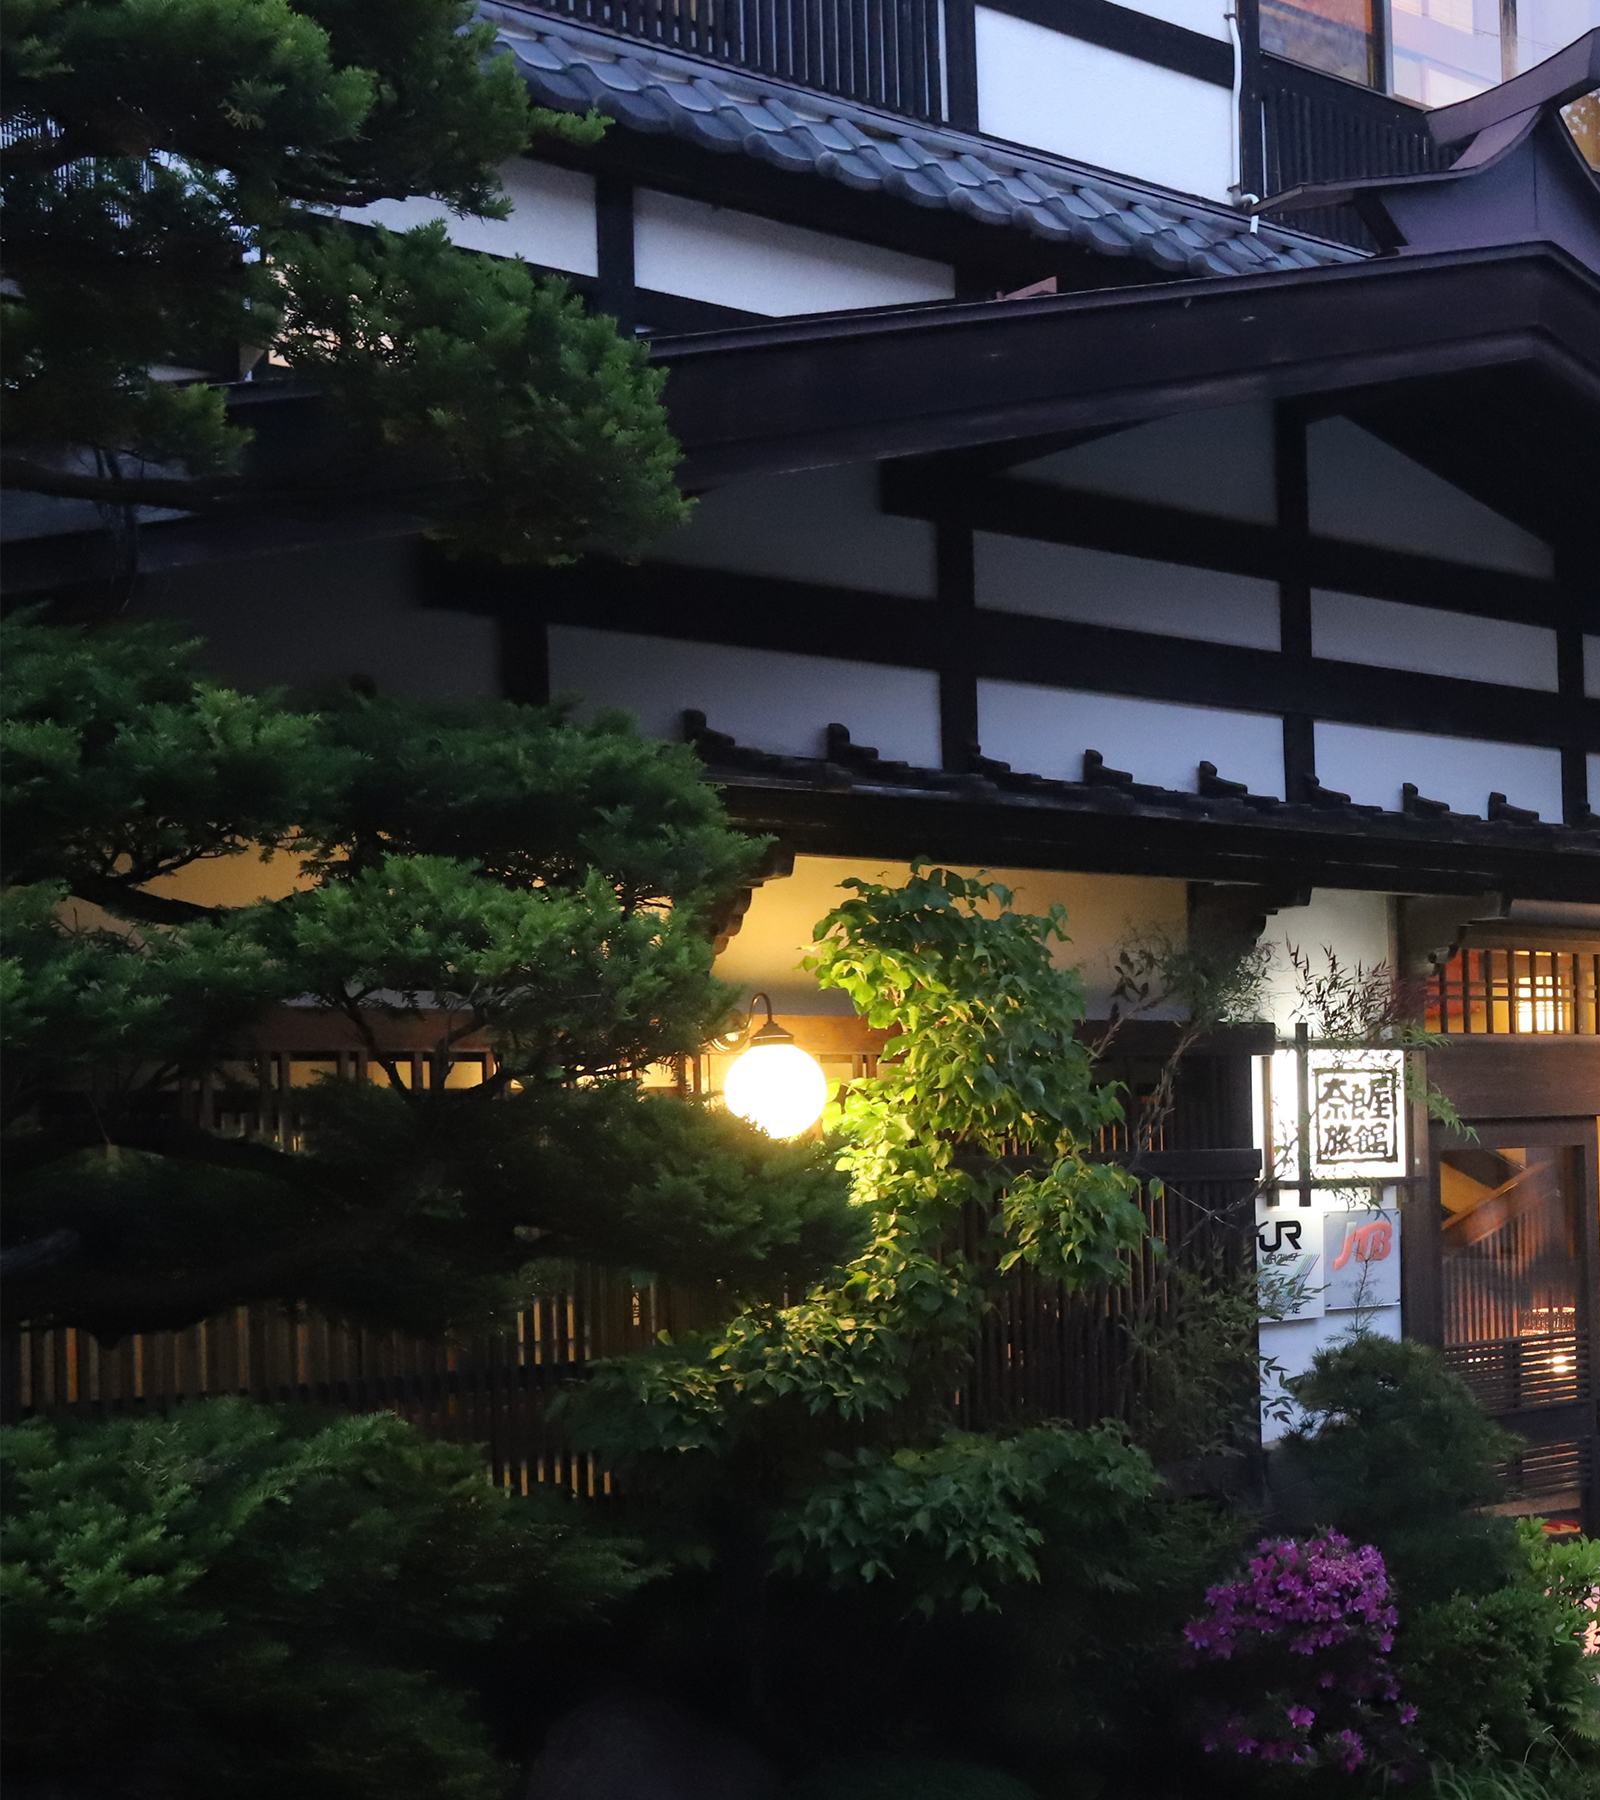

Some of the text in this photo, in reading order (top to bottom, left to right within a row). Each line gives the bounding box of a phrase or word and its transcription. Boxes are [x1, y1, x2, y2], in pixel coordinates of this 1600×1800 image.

[1319, 1077, 1391, 1120] 奈良屋
[1322, 1122, 1388, 1156] 旅館
[1258, 1219, 1302, 1252] JR
[1332, 1220, 1393, 1272] JTB
